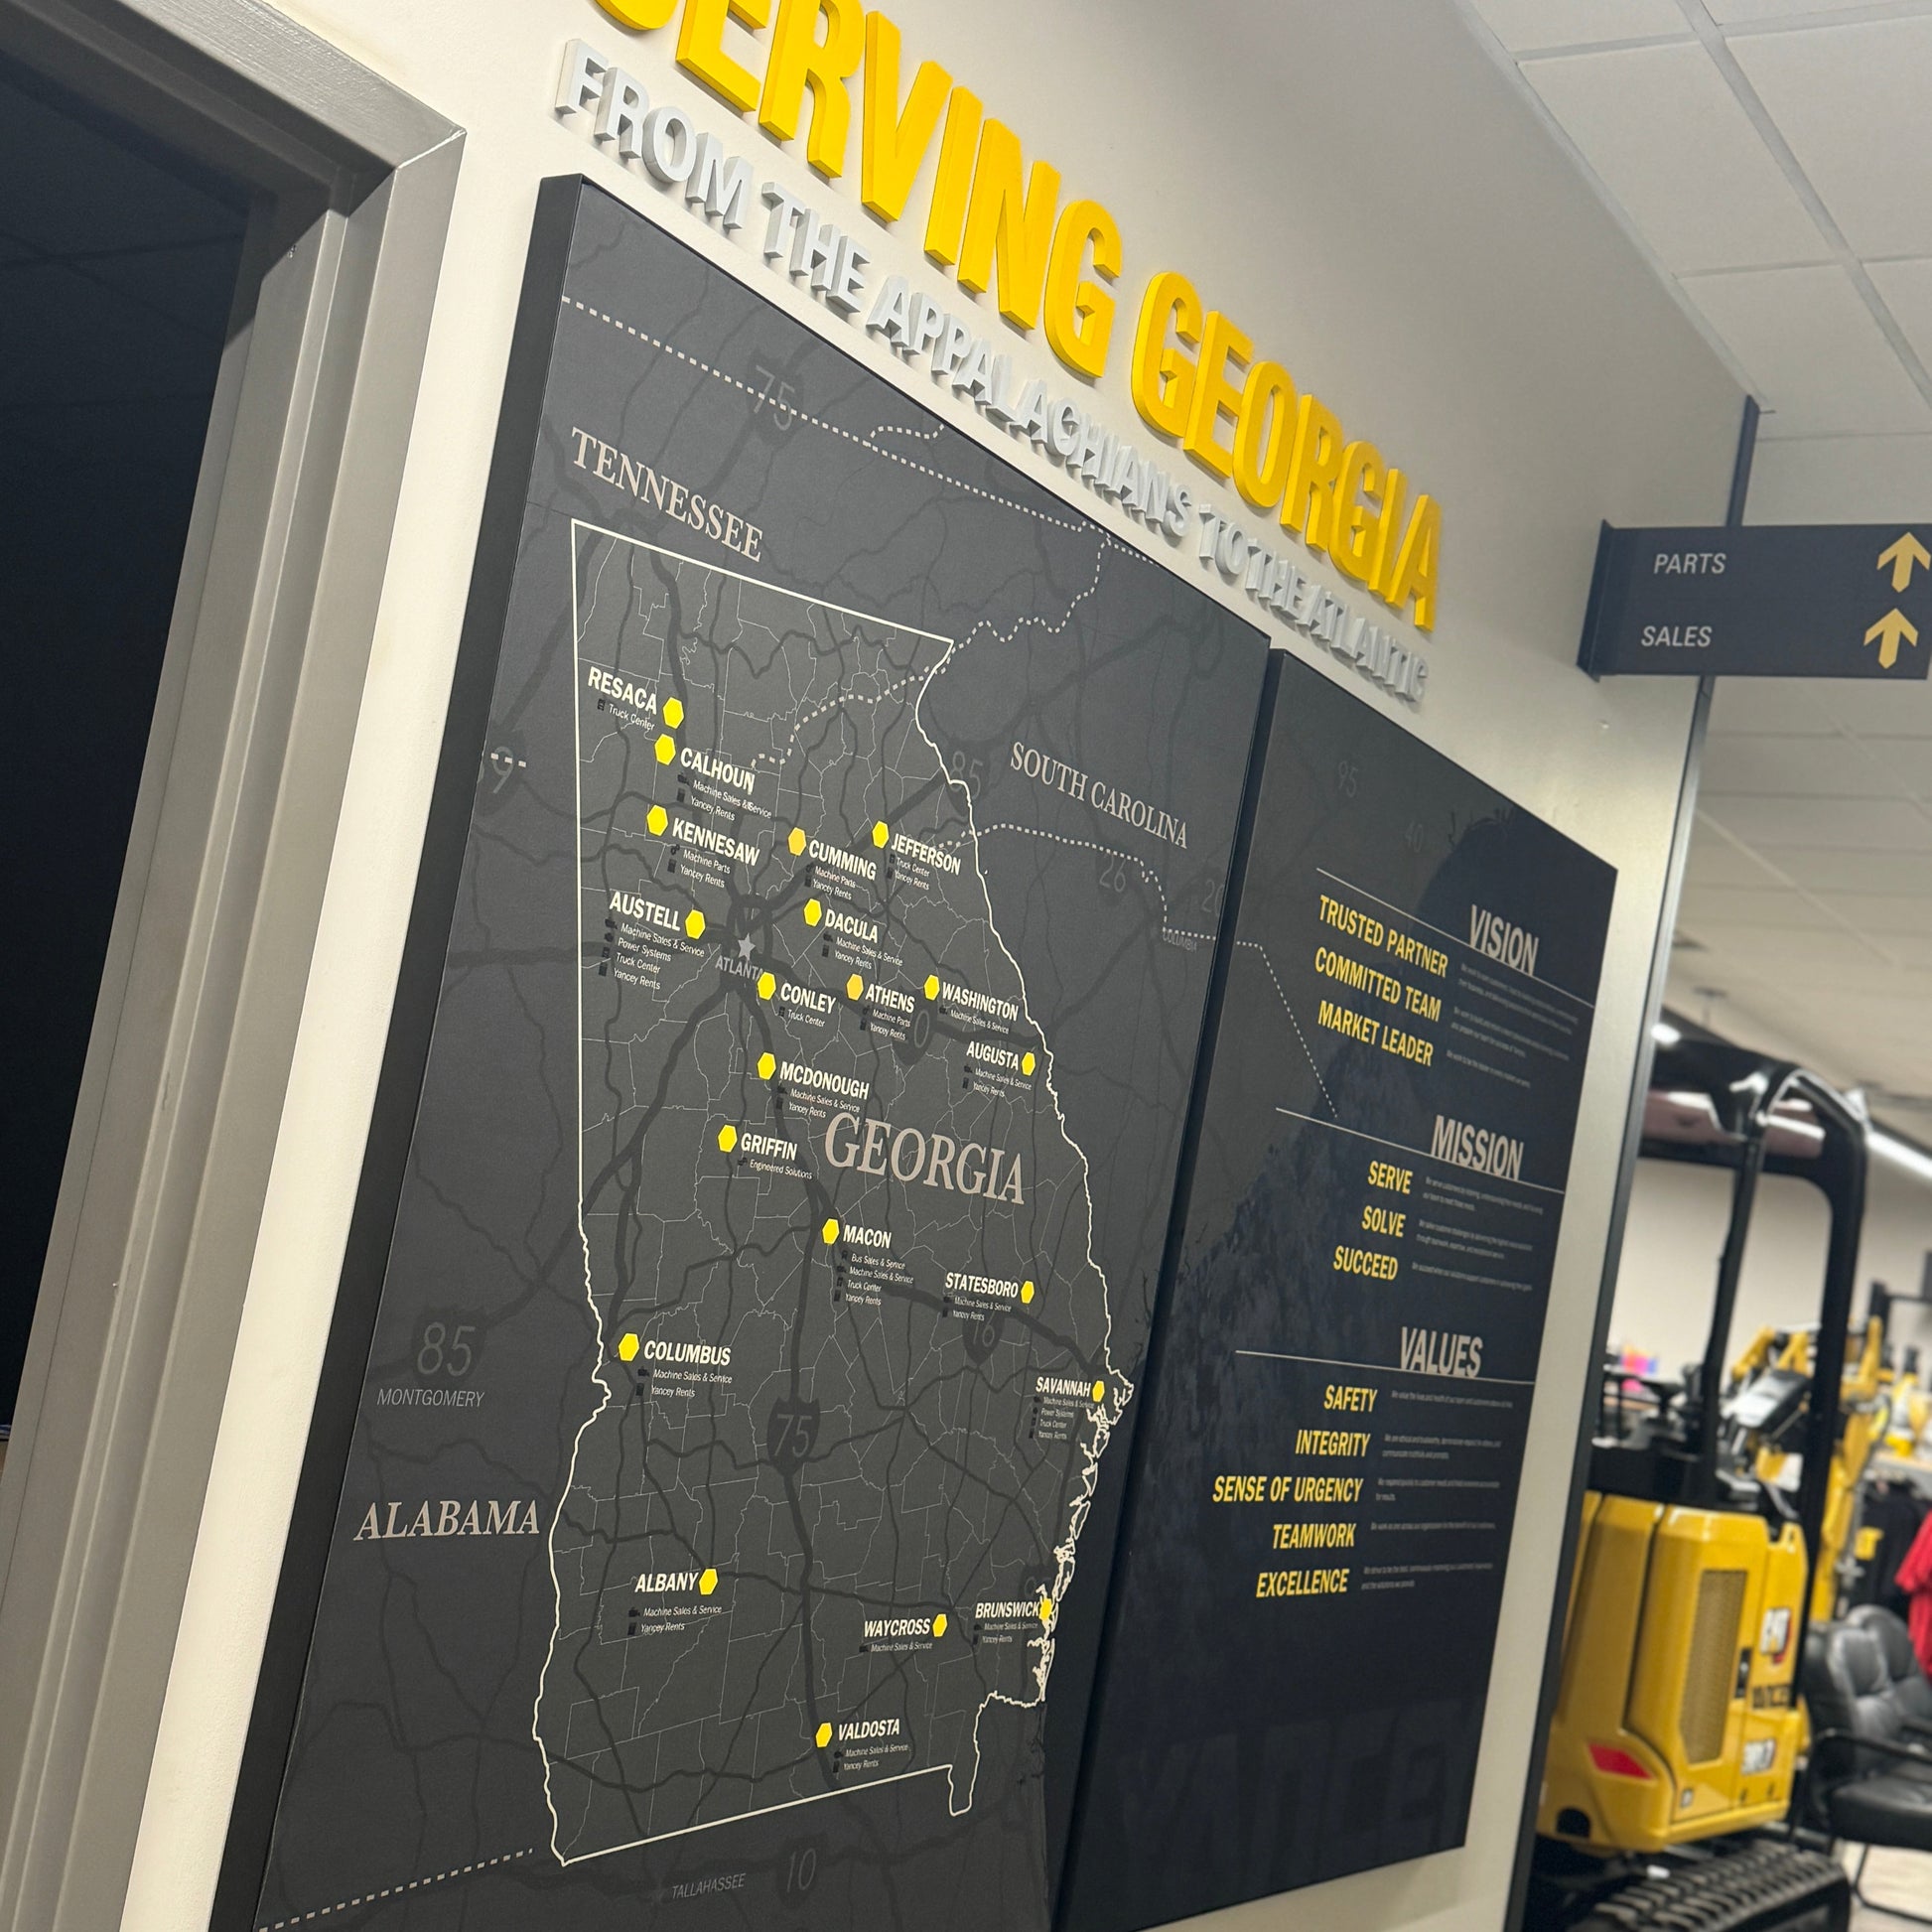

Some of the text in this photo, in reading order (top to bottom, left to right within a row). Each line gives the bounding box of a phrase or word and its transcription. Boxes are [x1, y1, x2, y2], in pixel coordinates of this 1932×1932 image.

[594, 0, 1442, 632] RVING GEORGIA
[555, 39, 1429, 703] FROM THE APPALACHIANS TO THE ATLANTIC
[571, 426, 764, 562] TENNESSEE
[1654, 553, 1726, 575] PARTS
[1641, 625, 1712, 647] SALES
[588, 666, 657, 715] RESACA
[609, 704, 654, 731] Truck Center
[681, 748, 756, 794] CALHOUN
[691, 796, 736, 821] Yancey Rents
[693, 779, 772, 819] Machine Sales & Service
[1011, 742, 1187, 849] SOUTH CAROLINA
[672, 817, 760, 866] KENNESAW
[892, 833, 961, 876] JEFFERSON
[683, 849, 731, 875] Machine Parts
[809, 840, 878, 881] CUMMING
[680, 865, 725, 888] Yancey Rents
[813, 879, 852, 900] Yancey Rents
[610, 892, 680, 931] AUSTELL
[621, 923, 650, 942] Machine
[651, 932, 671, 946] Sales
[679, 942, 705, 957] Service
[825, 909, 878, 943] DACULA
[1318, 895, 1448, 978] TRUSTED PARTNER
[1470, 903, 1539, 977] VISION
[617, 952, 661, 974] Truck Center
[619, 937, 672, 962] Power Systems
[835, 951, 872, 970] Yancey Rents
[836, 937, 861, 952] Machine
[862, 947, 877, 959] Sales
[884, 953, 903, 966] Service
[614, 968, 661, 990] Yancey Rents
[1314, 947, 1401, 1005] COMMITTED
[1405, 986, 1442, 1023] TEAM
[781, 983, 836, 1015] CONLEY
[866, 984, 915, 1013] ATHENS
[943, 982, 1019, 1021] WASHINGTON
[788, 1010, 825, 1028] Truck Center
[1317, 1000, 1379, 1045] MARKET
[1382, 1026, 1434, 1067] LEADER
[967, 1041, 1020, 1070] AUGUSTA
[779, 1061, 870, 1099] MCDONOUGH
[788, 1102, 826, 1118] Yancey Rents
[790, 1089, 816, 1102] Machine
[817, 1095, 833, 1106] Sales
[840, 1101, 861, 1112] Service
[741, 1133, 798, 1161] GRIFFIN
[825, 1112, 1025, 1204] GEORGIA
[1431, 1114, 1524, 1180] MISSION
[750, 1160, 813, 1179] Engineered Solutions
[1368, 1161, 1413, 1194] SERVE
[1361, 1205, 1406, 1238] SOLVE
[843, 1225, 892, 1249] MACON
[1333, 1246, 1399, 1281] SUCCEED
[945, 1272, 1018, 1299] STATESBORO
[417, 1321, 477, 1377] 85
[644, 1340, 731, 1365] COLUMBUS
[1401, 1326, 1483, 1378] VALUES
[653, 1369, 733, 1384] Machine Sales & Service
[1035, 1377, 1091, 1397] SAVANNAH
[377, 1389, 484, 1407] MONTGOMERY
[651, 1386, 695, 1398] Yancey Rents
[1323, 1385, 1378, 1412] SAFETY
[774, 1414, 811, 1457] 75
[1296, 1430, 1370, 1456] INTEGRITY
[1212, 1475, 1363, 1502] SENSE OF URGENCY
[353, 1500, 540, 1541] ALABAMA
[1273, 1523, 1356, 1549] TEAMWORK
[635, 1573, 699, 1592] ALBANY
[1256, 1569, 1349, 1597] EXCELLENCE
[643, 1607, 672, 1617] Machine
[673, 1606, 691, 1615] Sales
[699, 1605, 722, 1614] Service
[975, 1602, 1039, 1618] BRUNSWICK
[641, 1622, 685, 1633] Yancey Rents
[864, 1618, 930, 1637] WAYCROSS
[838, 1719, 899, 1741] VALDOSTA
[786, 1848, 816, 1893] 10
[672, 1873, 746, 1899] TALLAHASSEE
